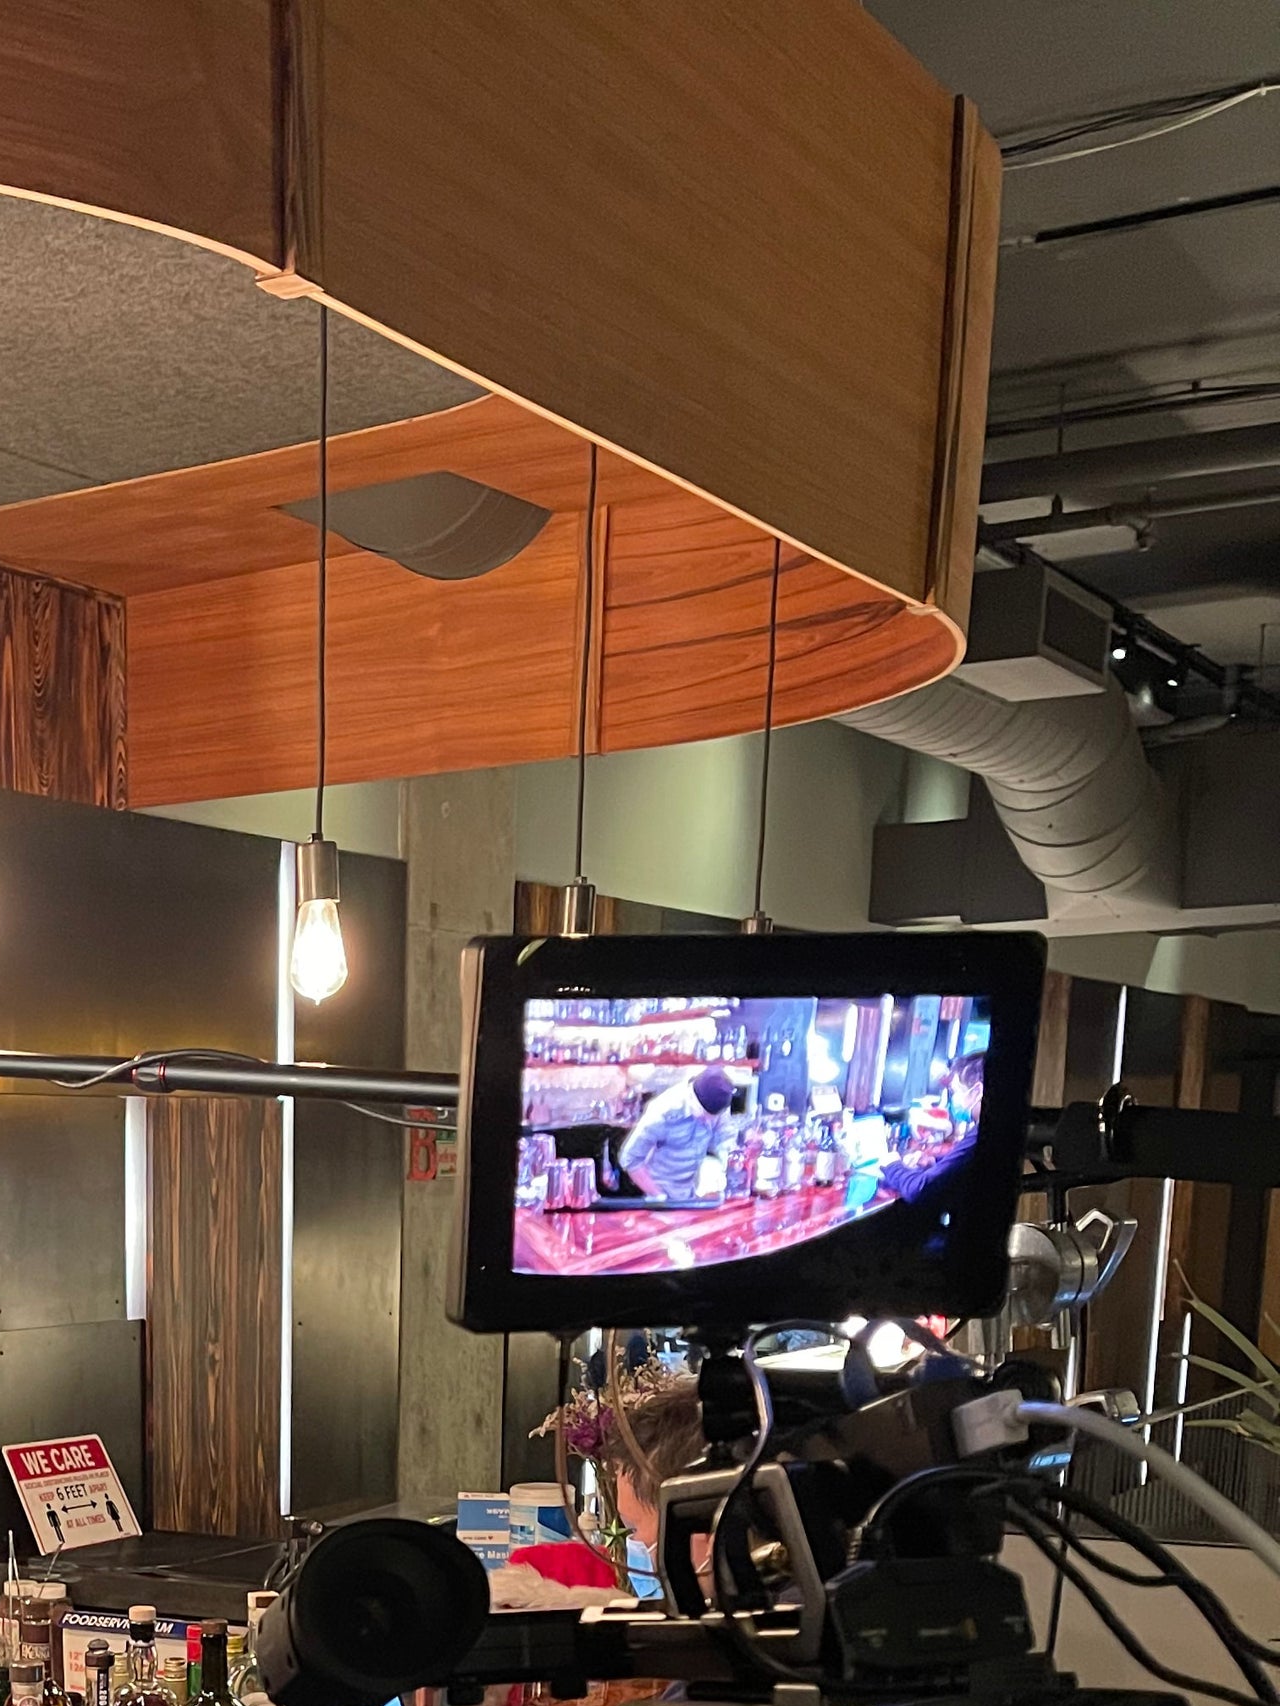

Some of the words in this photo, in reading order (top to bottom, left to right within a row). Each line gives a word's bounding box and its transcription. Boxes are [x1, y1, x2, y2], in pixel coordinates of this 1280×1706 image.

[20, 1450, 52, 1475] WE
[50, 1444, 95, 1471] CARE
[38, 1491, 55, 1502] KEEP
[55, 1487, 65, 1501] 6
[64, 1483, 88, 1500] FEET
[88, 1482, 108, 1494] APART
[66, 1520, 74, 1528] AT
[75, 1517, 88, 1527] ALL
[87, 1514, 106, 1525] TIMES
[62, 1613, 130, 1629] FOODSERVI
